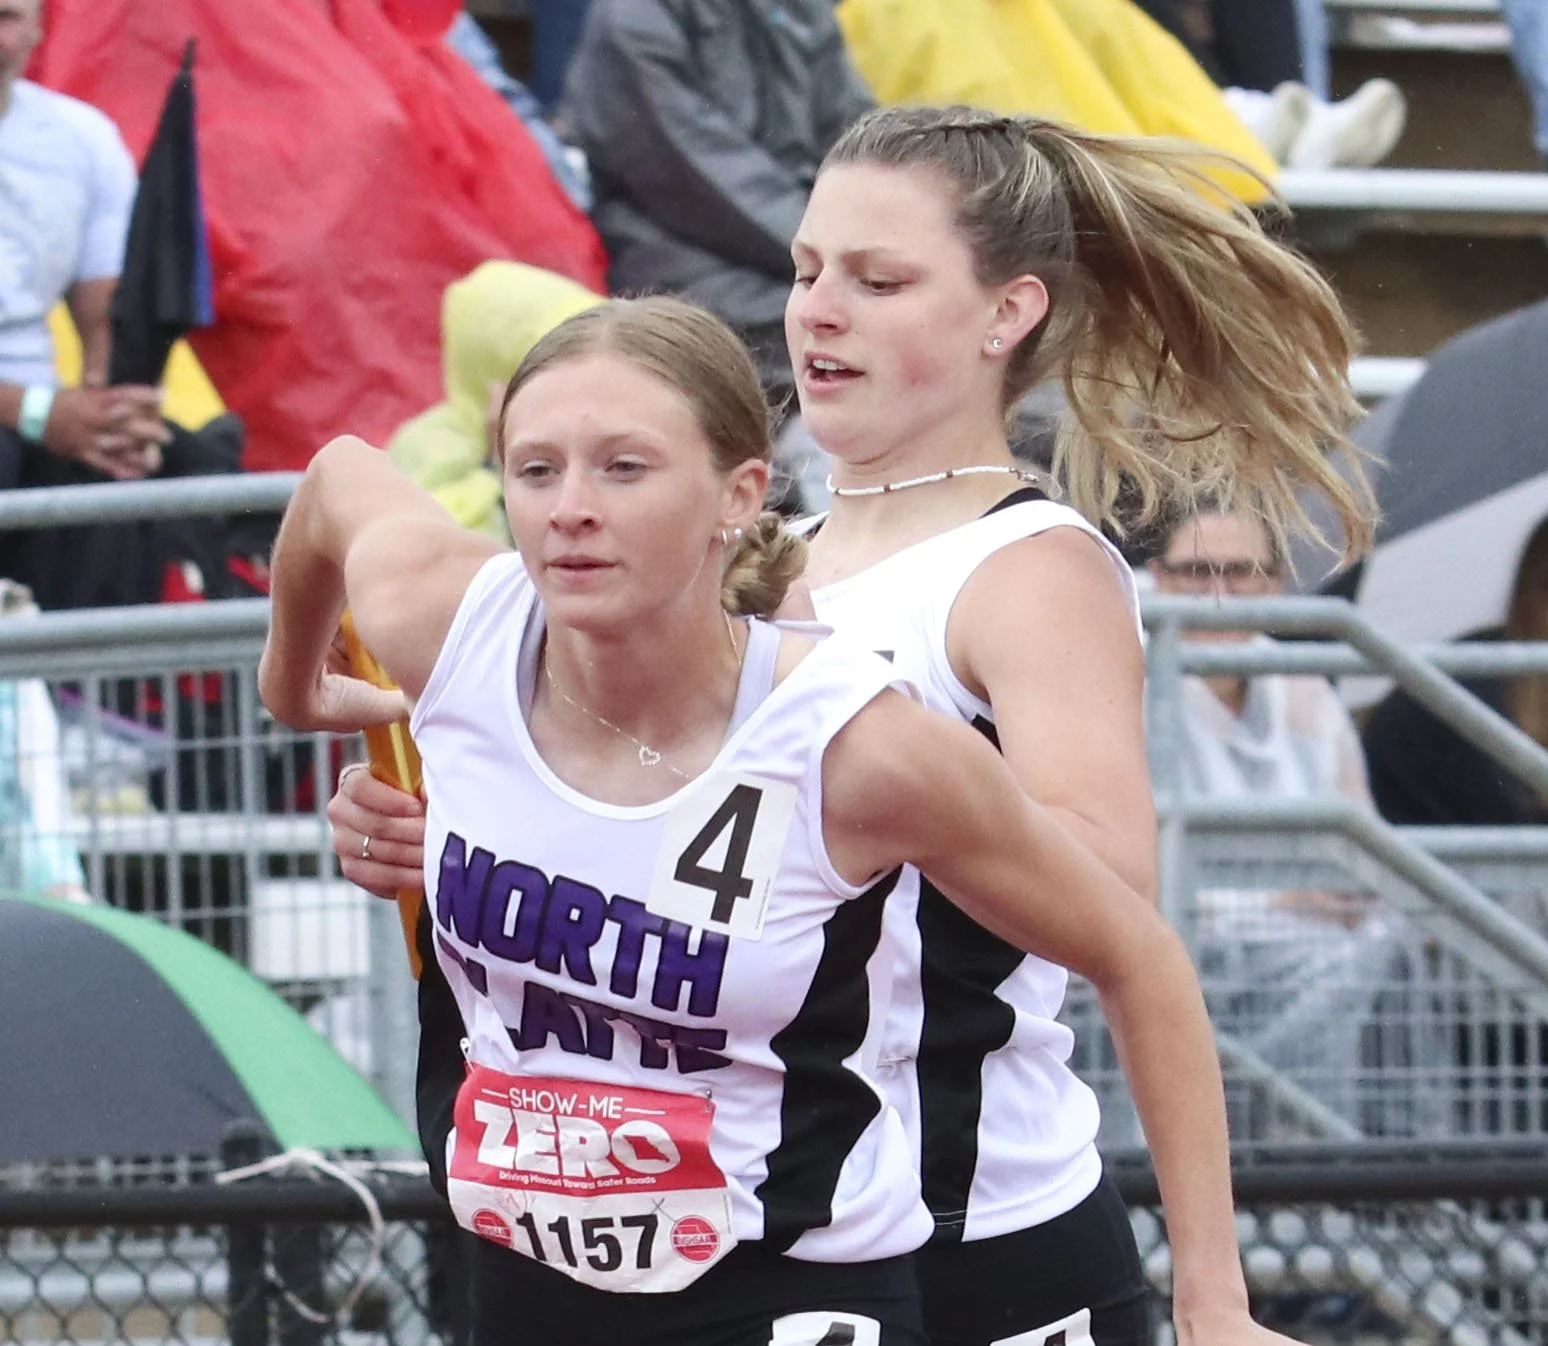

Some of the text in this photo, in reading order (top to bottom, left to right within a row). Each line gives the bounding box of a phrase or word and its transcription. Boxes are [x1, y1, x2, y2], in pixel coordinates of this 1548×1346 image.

[674, 783, 763, 925] 4
[436, 831, 729, 1017] NORTH
[508, 1087, 624, 1119] SHOW-ME
[473, 1099, 681, 1179] ZERO
[499, 1170, 530, 1185] Driving
[515, 1212, 658, 1272] 1157
